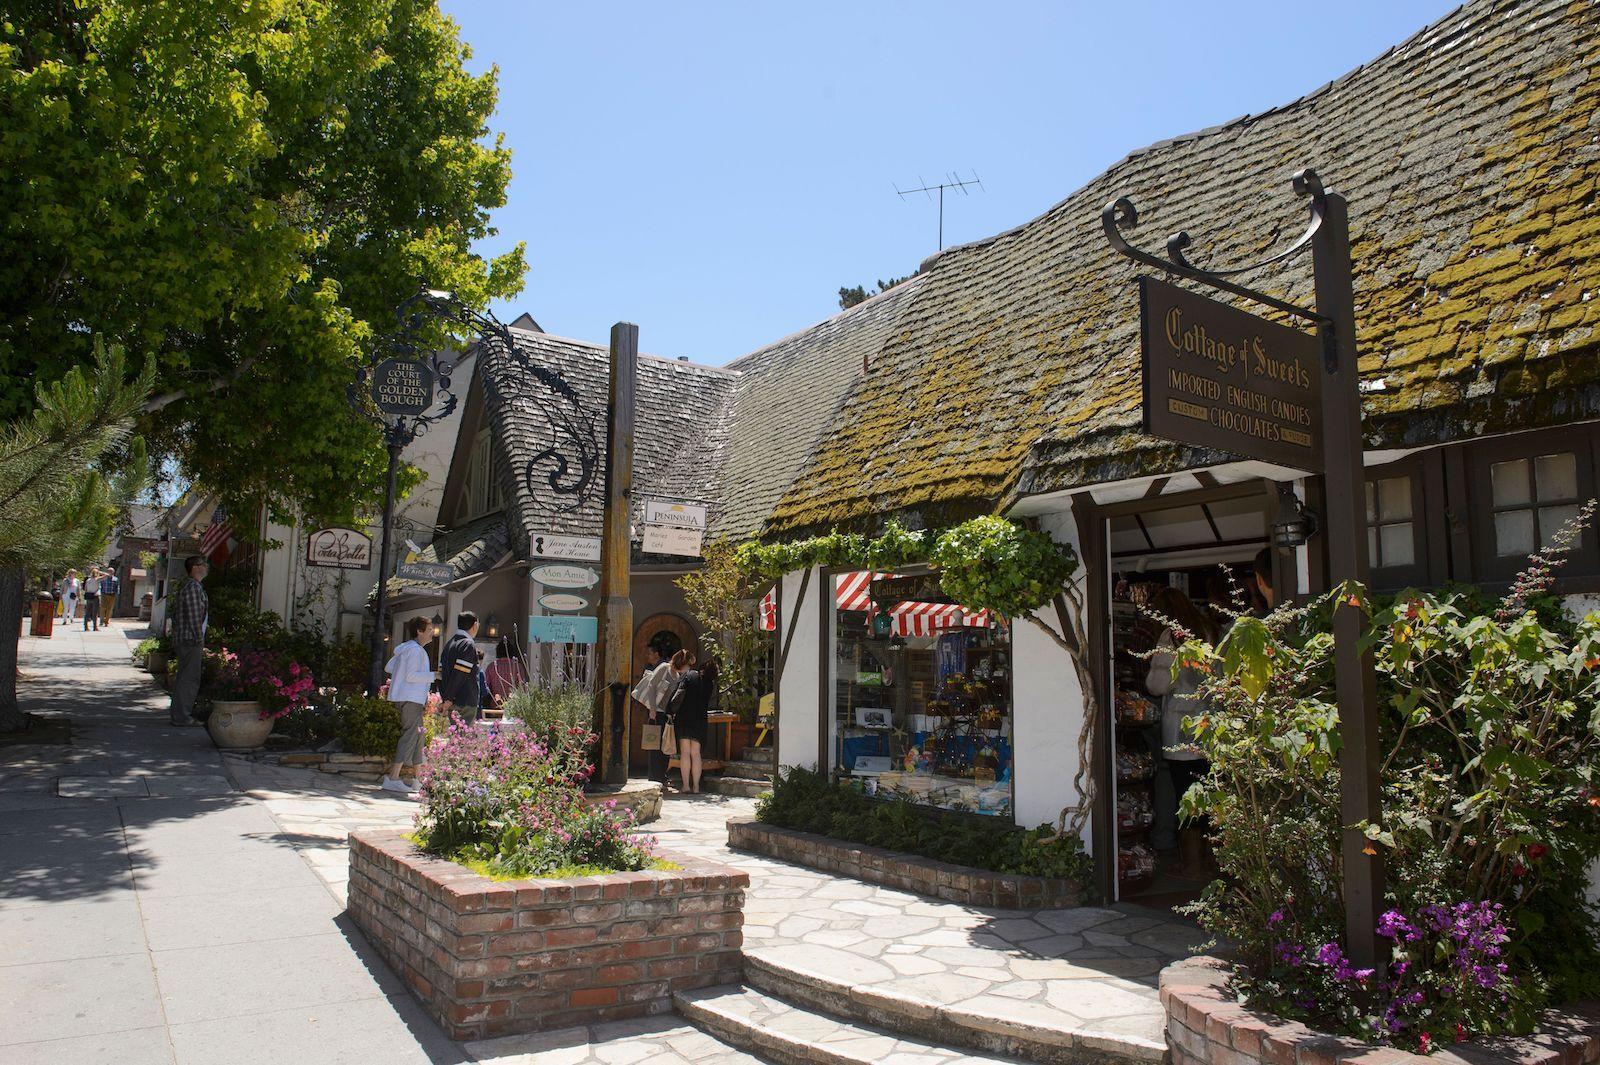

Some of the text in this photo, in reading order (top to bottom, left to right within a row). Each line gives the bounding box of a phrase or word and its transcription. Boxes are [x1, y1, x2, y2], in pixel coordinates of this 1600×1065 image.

[1165, 305, 1310, 390] Cottage of Sweets
[396, 362, 416, 370] THE
[388, 370, 421, 379] COURT
[379, 385, 427, 396] GOLDEN
[381, 394, 423, 406] BOUGH
[1168, 368, 1311, 426] IMPORTED ENGLISH CANDIES
[1210, 407, 1279, 442] CHOCOLATES
[654, 512, 698, 525] PENINSULA
[545, 538, 598, 550] Jane Austen
[565, 549, 591, 557] Home
[425, 566, 452, 578] Rabbit
[542, 568, 586, 579] Mon Amie
